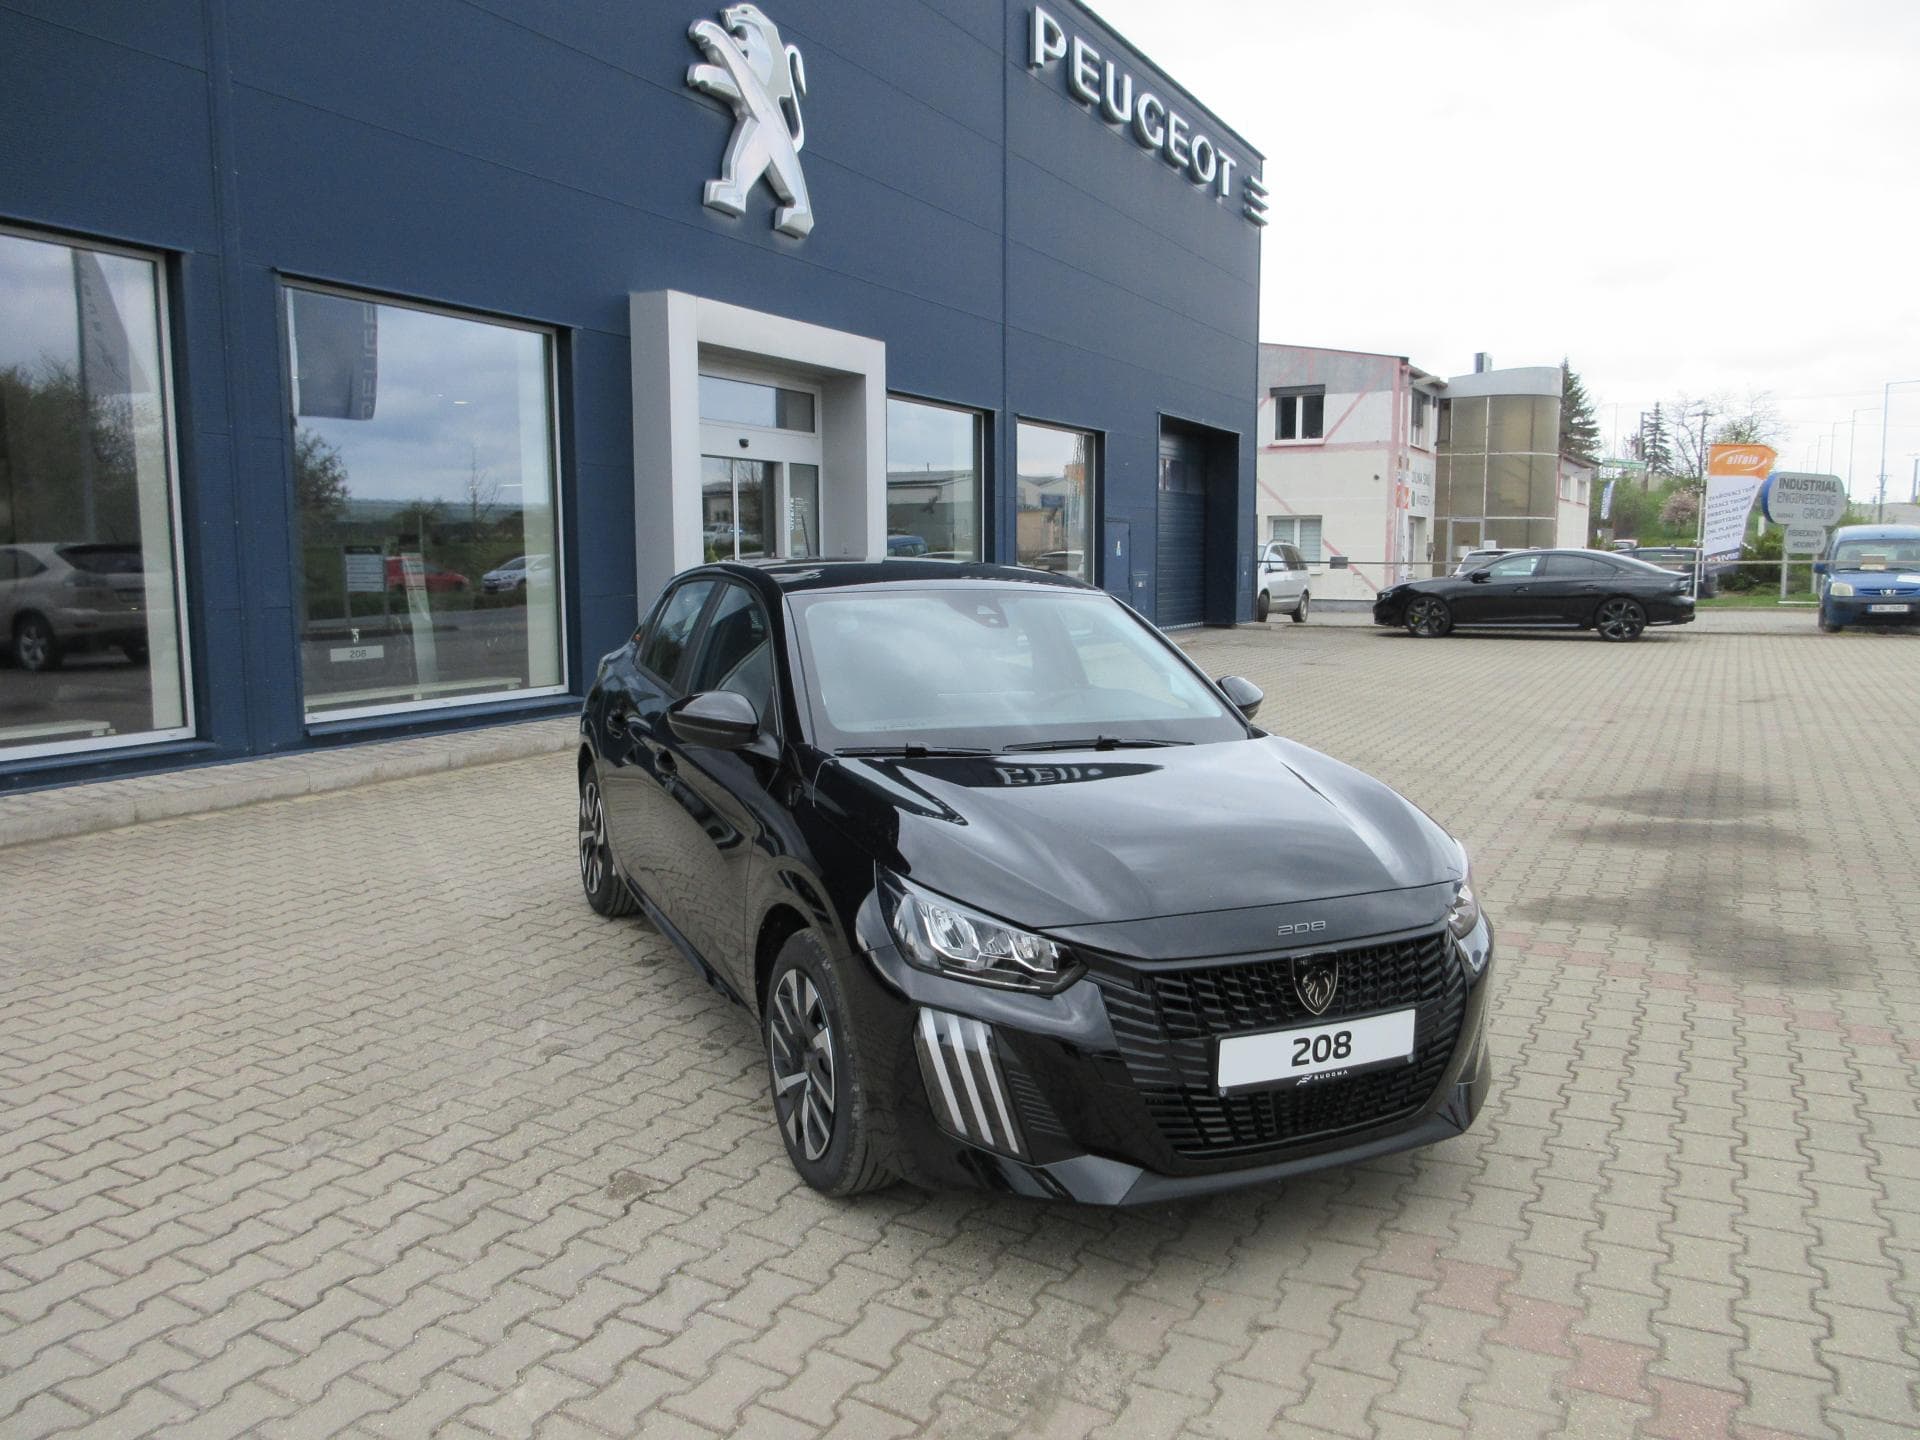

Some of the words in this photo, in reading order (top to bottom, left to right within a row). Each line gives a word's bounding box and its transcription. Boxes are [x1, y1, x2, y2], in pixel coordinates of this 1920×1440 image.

[1030, 6, 1236, 197] PEUGEOT
[1778, 478, 1837, 493] INDUSTRIAL
[1776, 491, 1837, 506] ENGINEERING
[1802, 507, 1835, 520] GROUP
[1278, 920, 1326, 936] 208
[1291, 1030, 1352, 1067] 208
